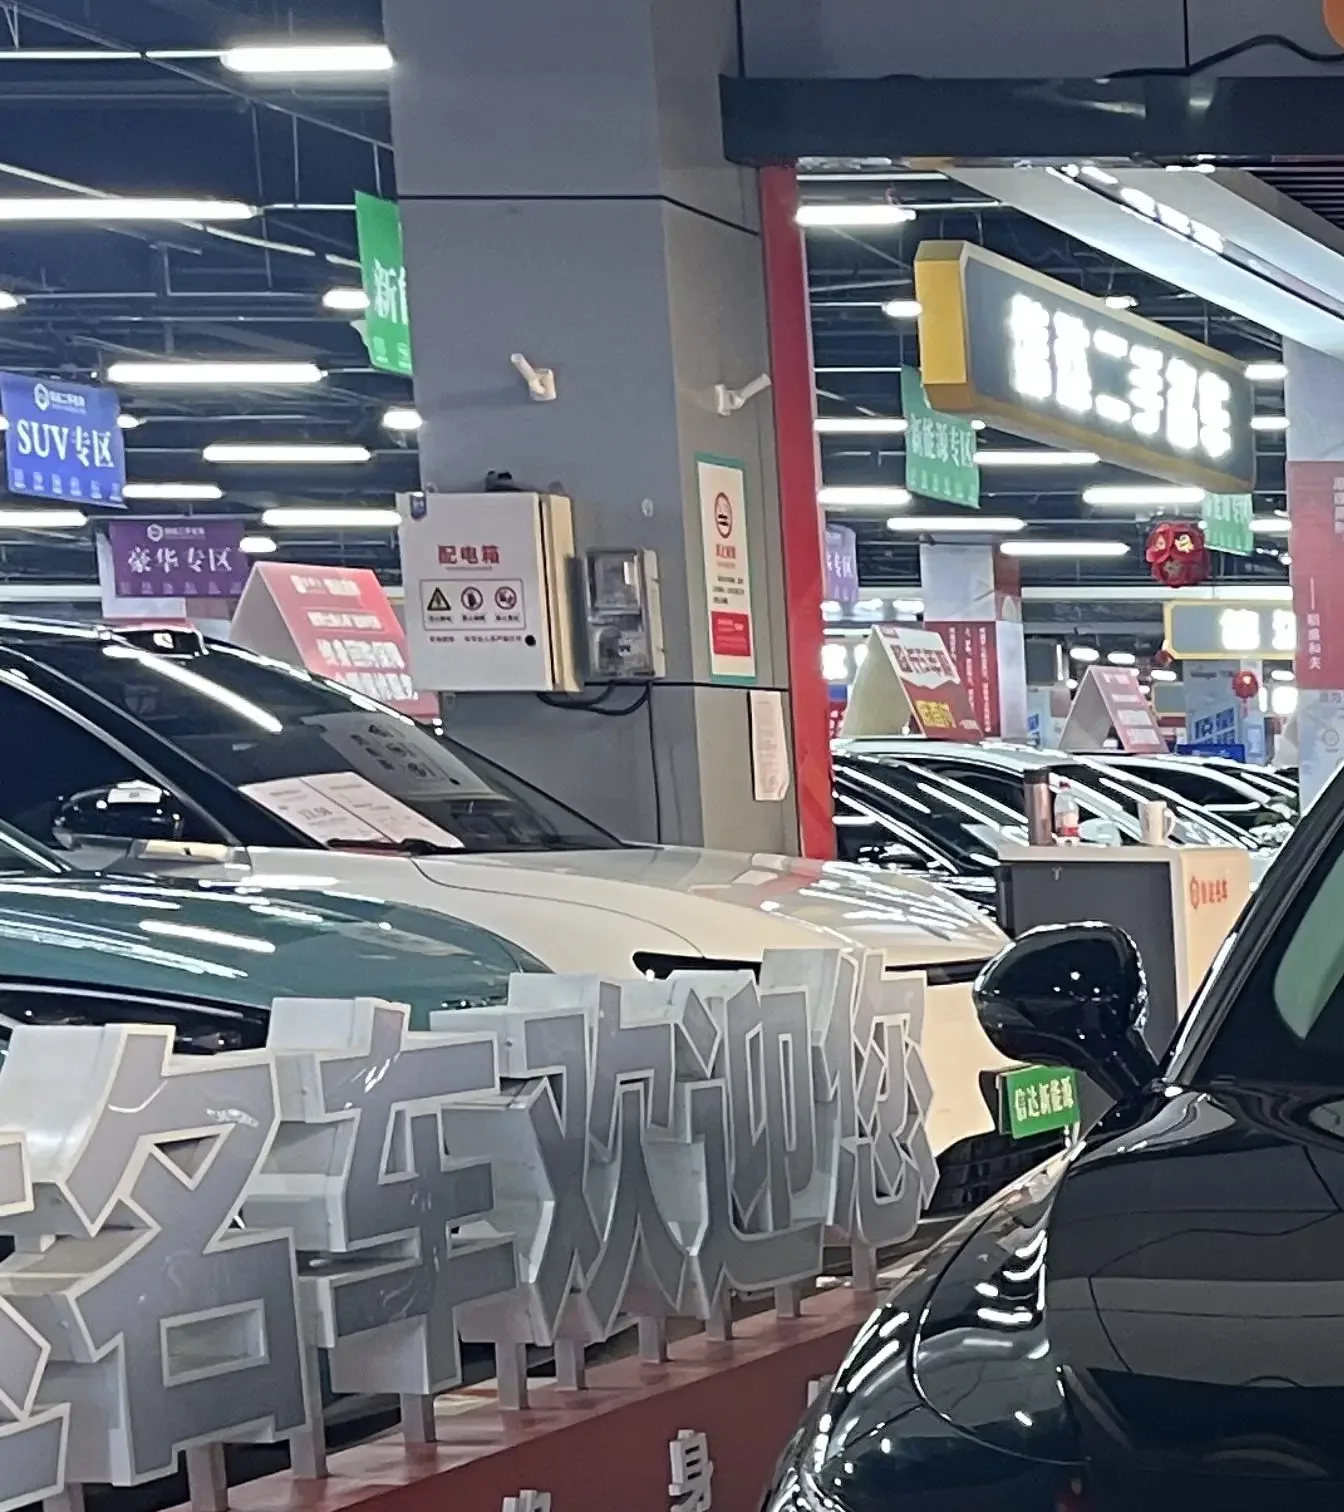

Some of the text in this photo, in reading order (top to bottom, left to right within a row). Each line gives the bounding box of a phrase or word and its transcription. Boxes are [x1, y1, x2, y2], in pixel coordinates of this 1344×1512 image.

[17, 418, 115, 468] SUV专区
[437, 545, 500, 565] 配电箱
